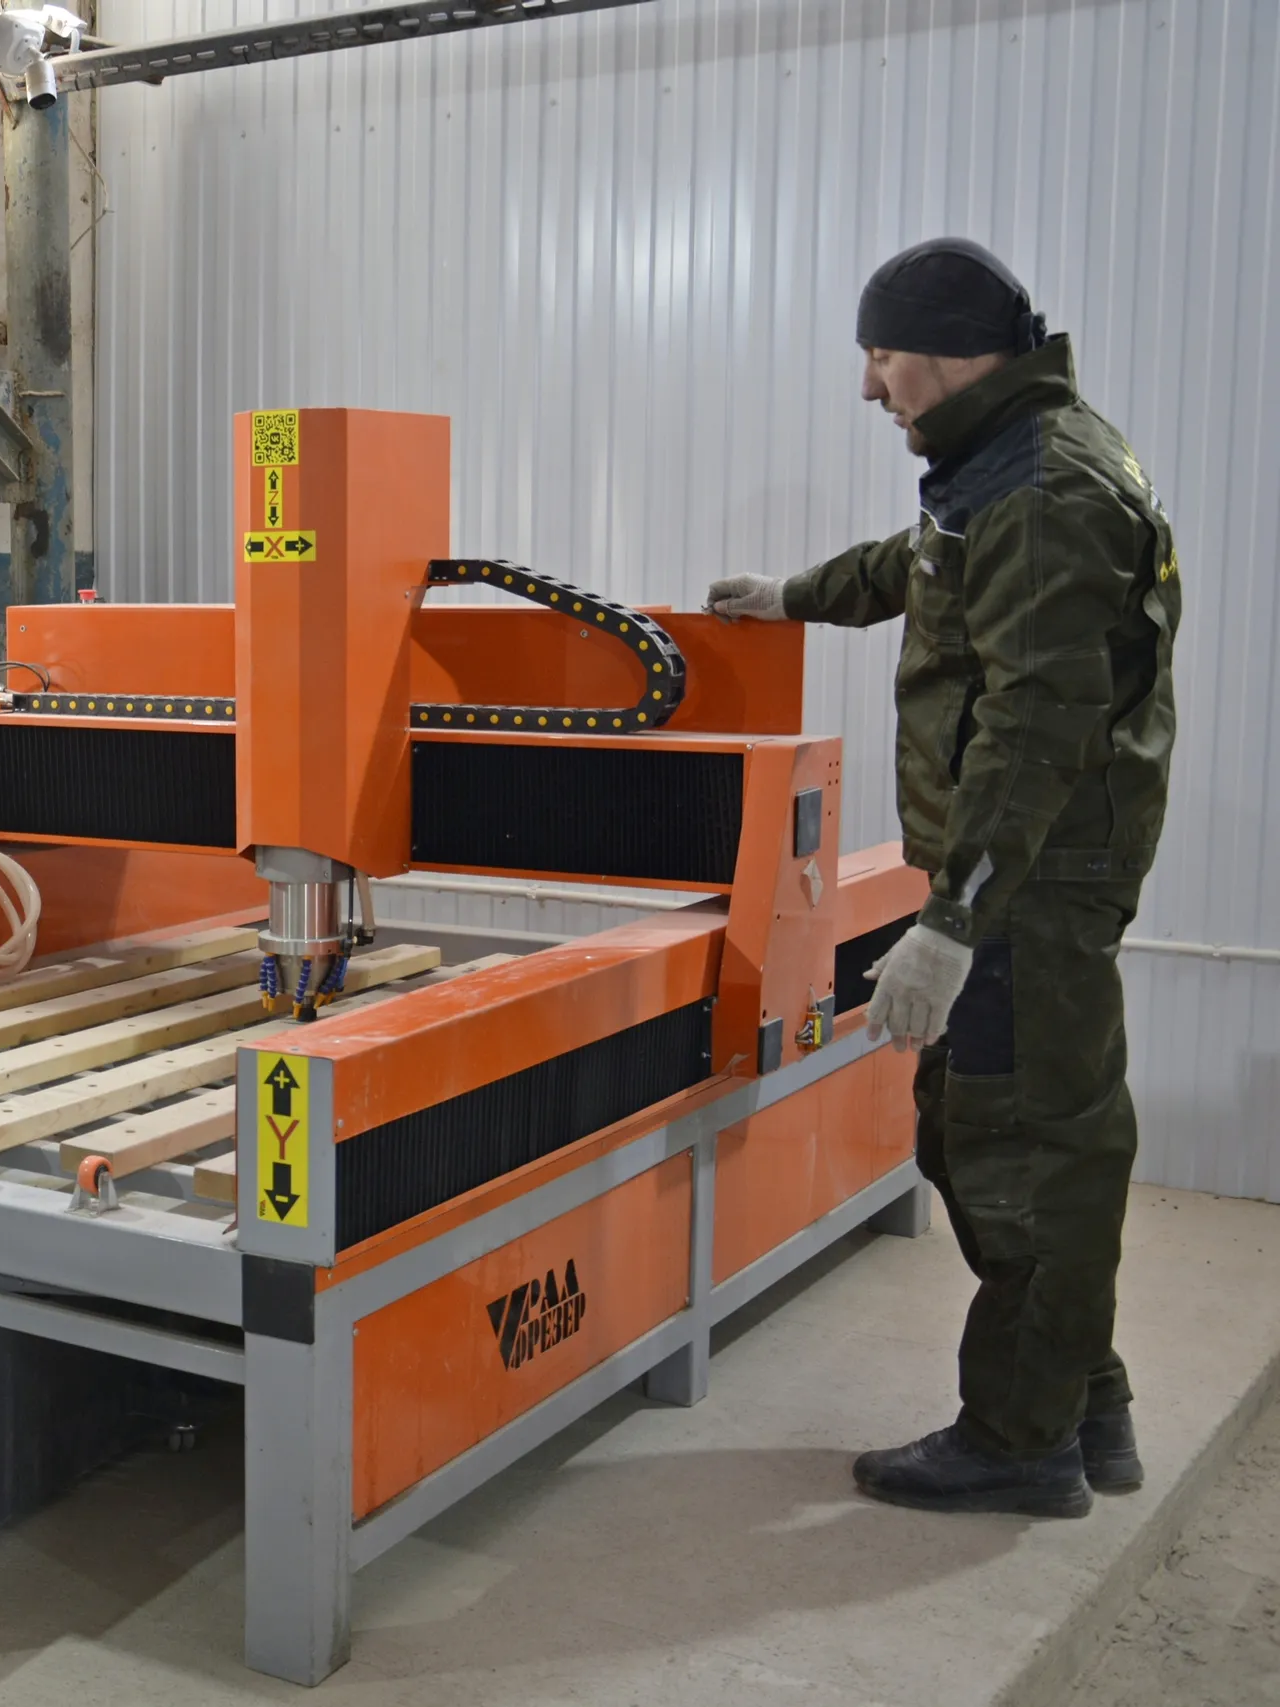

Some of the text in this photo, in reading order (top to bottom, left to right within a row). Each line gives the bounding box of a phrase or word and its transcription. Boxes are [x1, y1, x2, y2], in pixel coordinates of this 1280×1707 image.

[268, 490, 279, 506] Z
[264, 536, 285, 558] X
[265, 1114, 300, 1161] Y
[510, 1292, 587, 1370] ФРЕЗЕР
